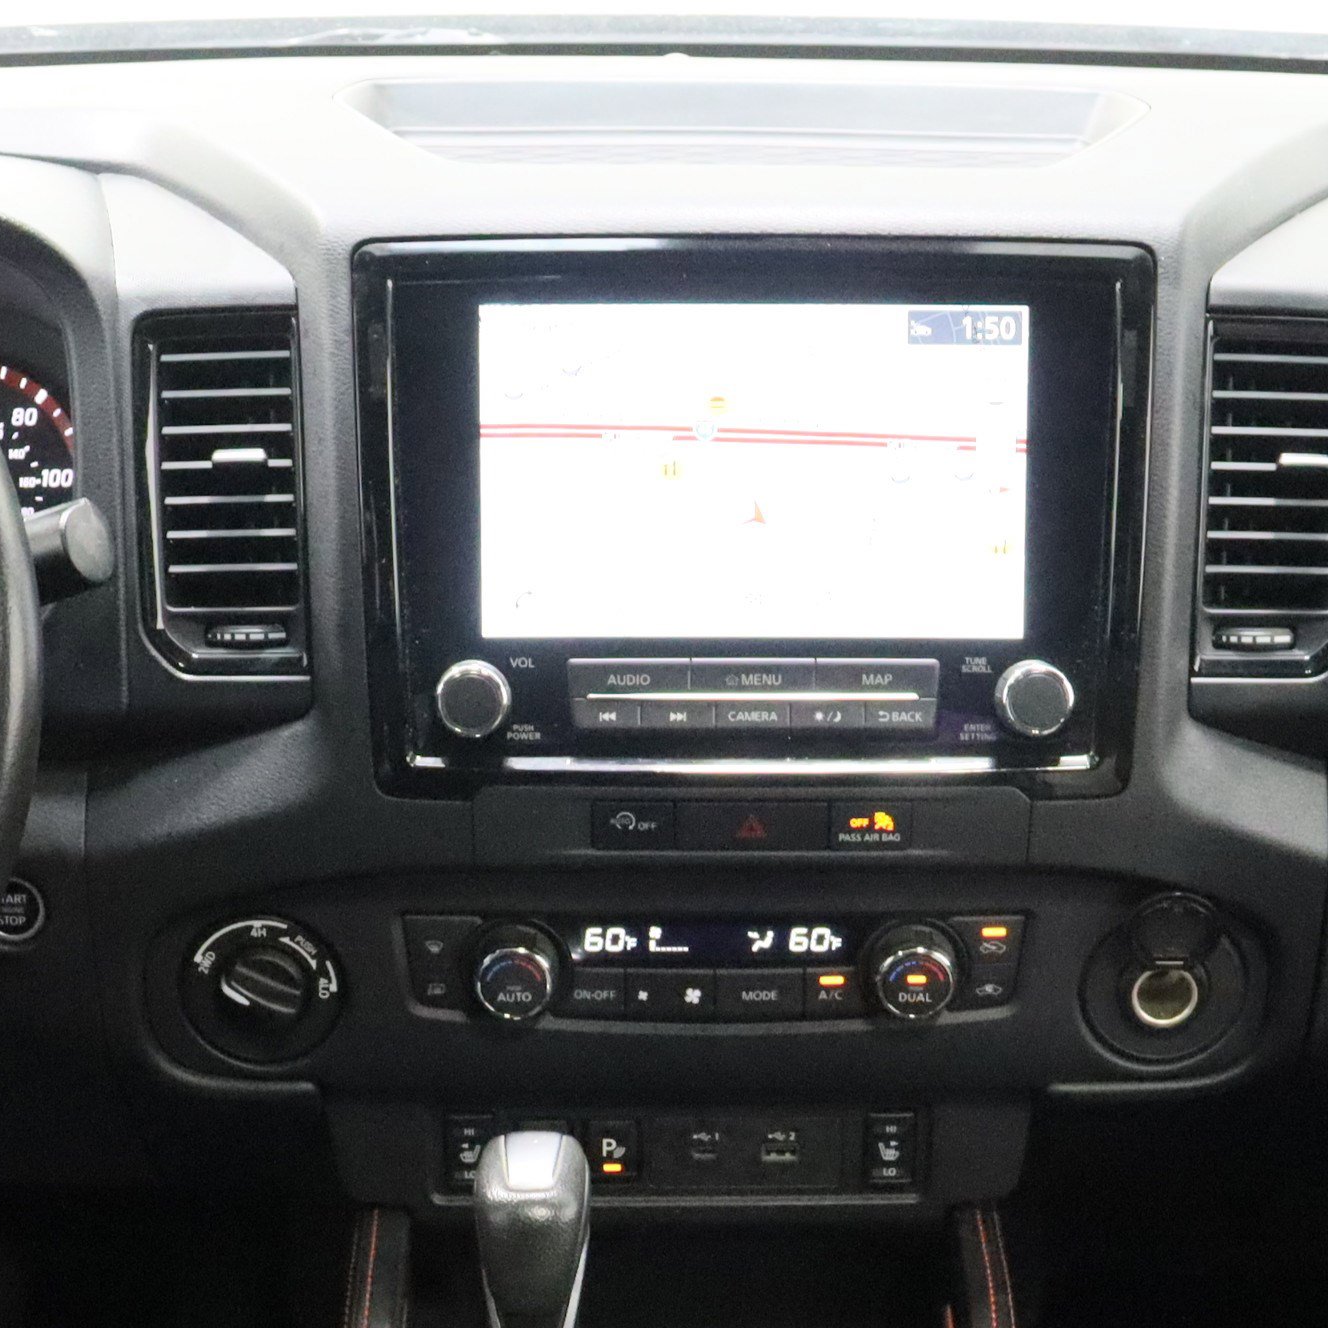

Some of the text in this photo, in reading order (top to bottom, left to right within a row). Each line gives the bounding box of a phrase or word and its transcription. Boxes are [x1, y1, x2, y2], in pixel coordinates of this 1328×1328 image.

[962, 315, 1017, 341] 1:50
[11, 407, 38, 427] 80
[41, 467, 74, 488] 100
[509, 656, 535, 669] VOL
[607, 674, 651, 686] AUDIO
[741, 673, 782, 686] MENU
[862, 673, 893, 686] MAP
[728, 711, 778, 722] CAMERA
[891, 711, 923, 723] BACK
[507, 732, 541, 741] POWER
[849, 817, 870, 829] OFF
[839, 833, 901, 842] PASS AIR BAG
[250, 927, 267, 938] 4H
[294, 935, 318, 956] PUSH
[198, 951, 216, 974] 2WD
[497, 991, 532, 1003] AUTO
[741, 990, 778, 1001] MODE
[818, 990, 843, 1001] A/C
[898, 992, 933, 1003] DUAL
[882, 1167, 897, 1177] LO
